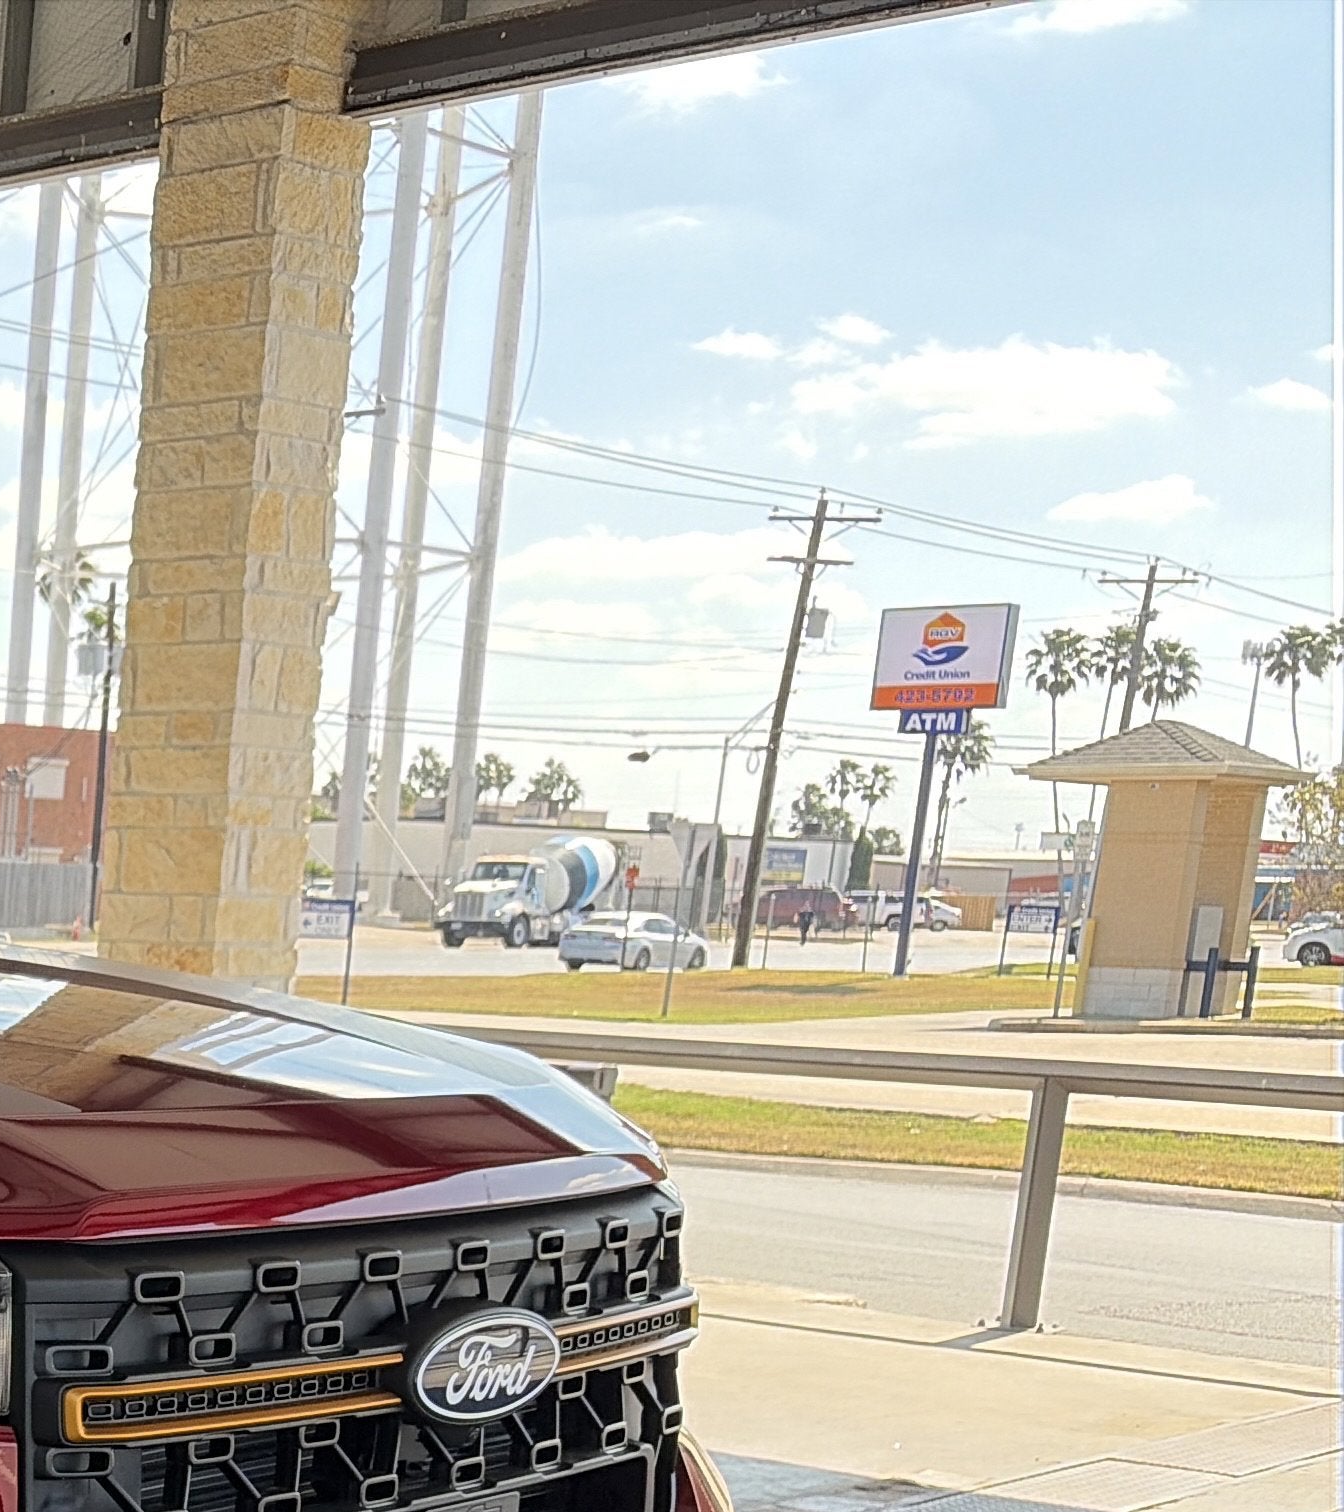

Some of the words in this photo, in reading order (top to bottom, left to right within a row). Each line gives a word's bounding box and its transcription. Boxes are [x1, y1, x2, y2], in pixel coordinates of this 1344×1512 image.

[904, 670, 936, 681] Credit
[938, 669, 970, 680] Union
[905, 713, 957, 731] ATM
[445, 1332, 536, 1405] Ford
